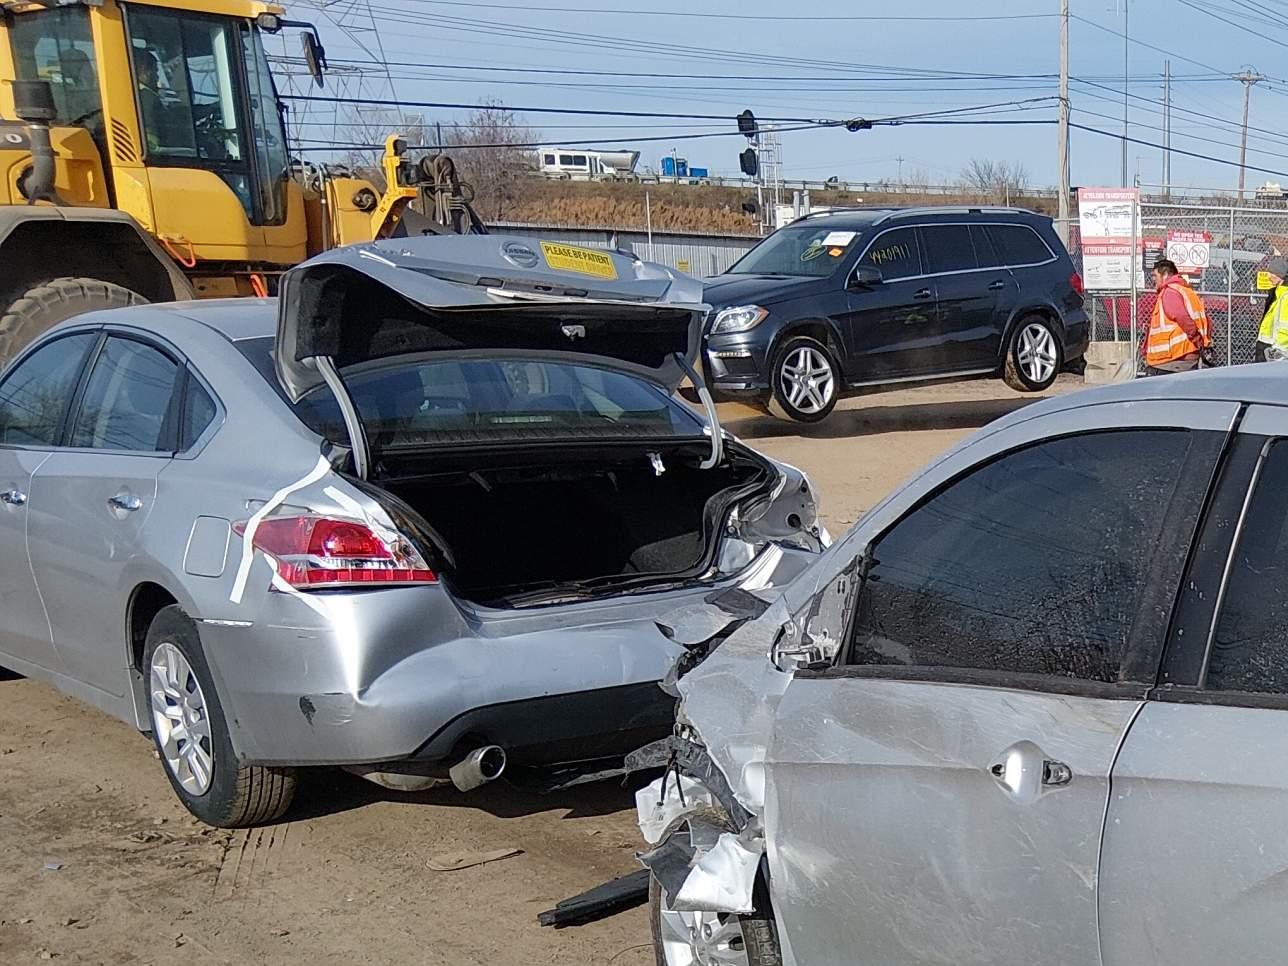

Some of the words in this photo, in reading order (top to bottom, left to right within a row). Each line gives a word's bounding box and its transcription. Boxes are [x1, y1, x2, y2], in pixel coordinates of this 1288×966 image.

[544, 245, 574, 258] PLEASE
[573, 249, 585, 259] BE
[584, 251, 610, 265] PATIENT
